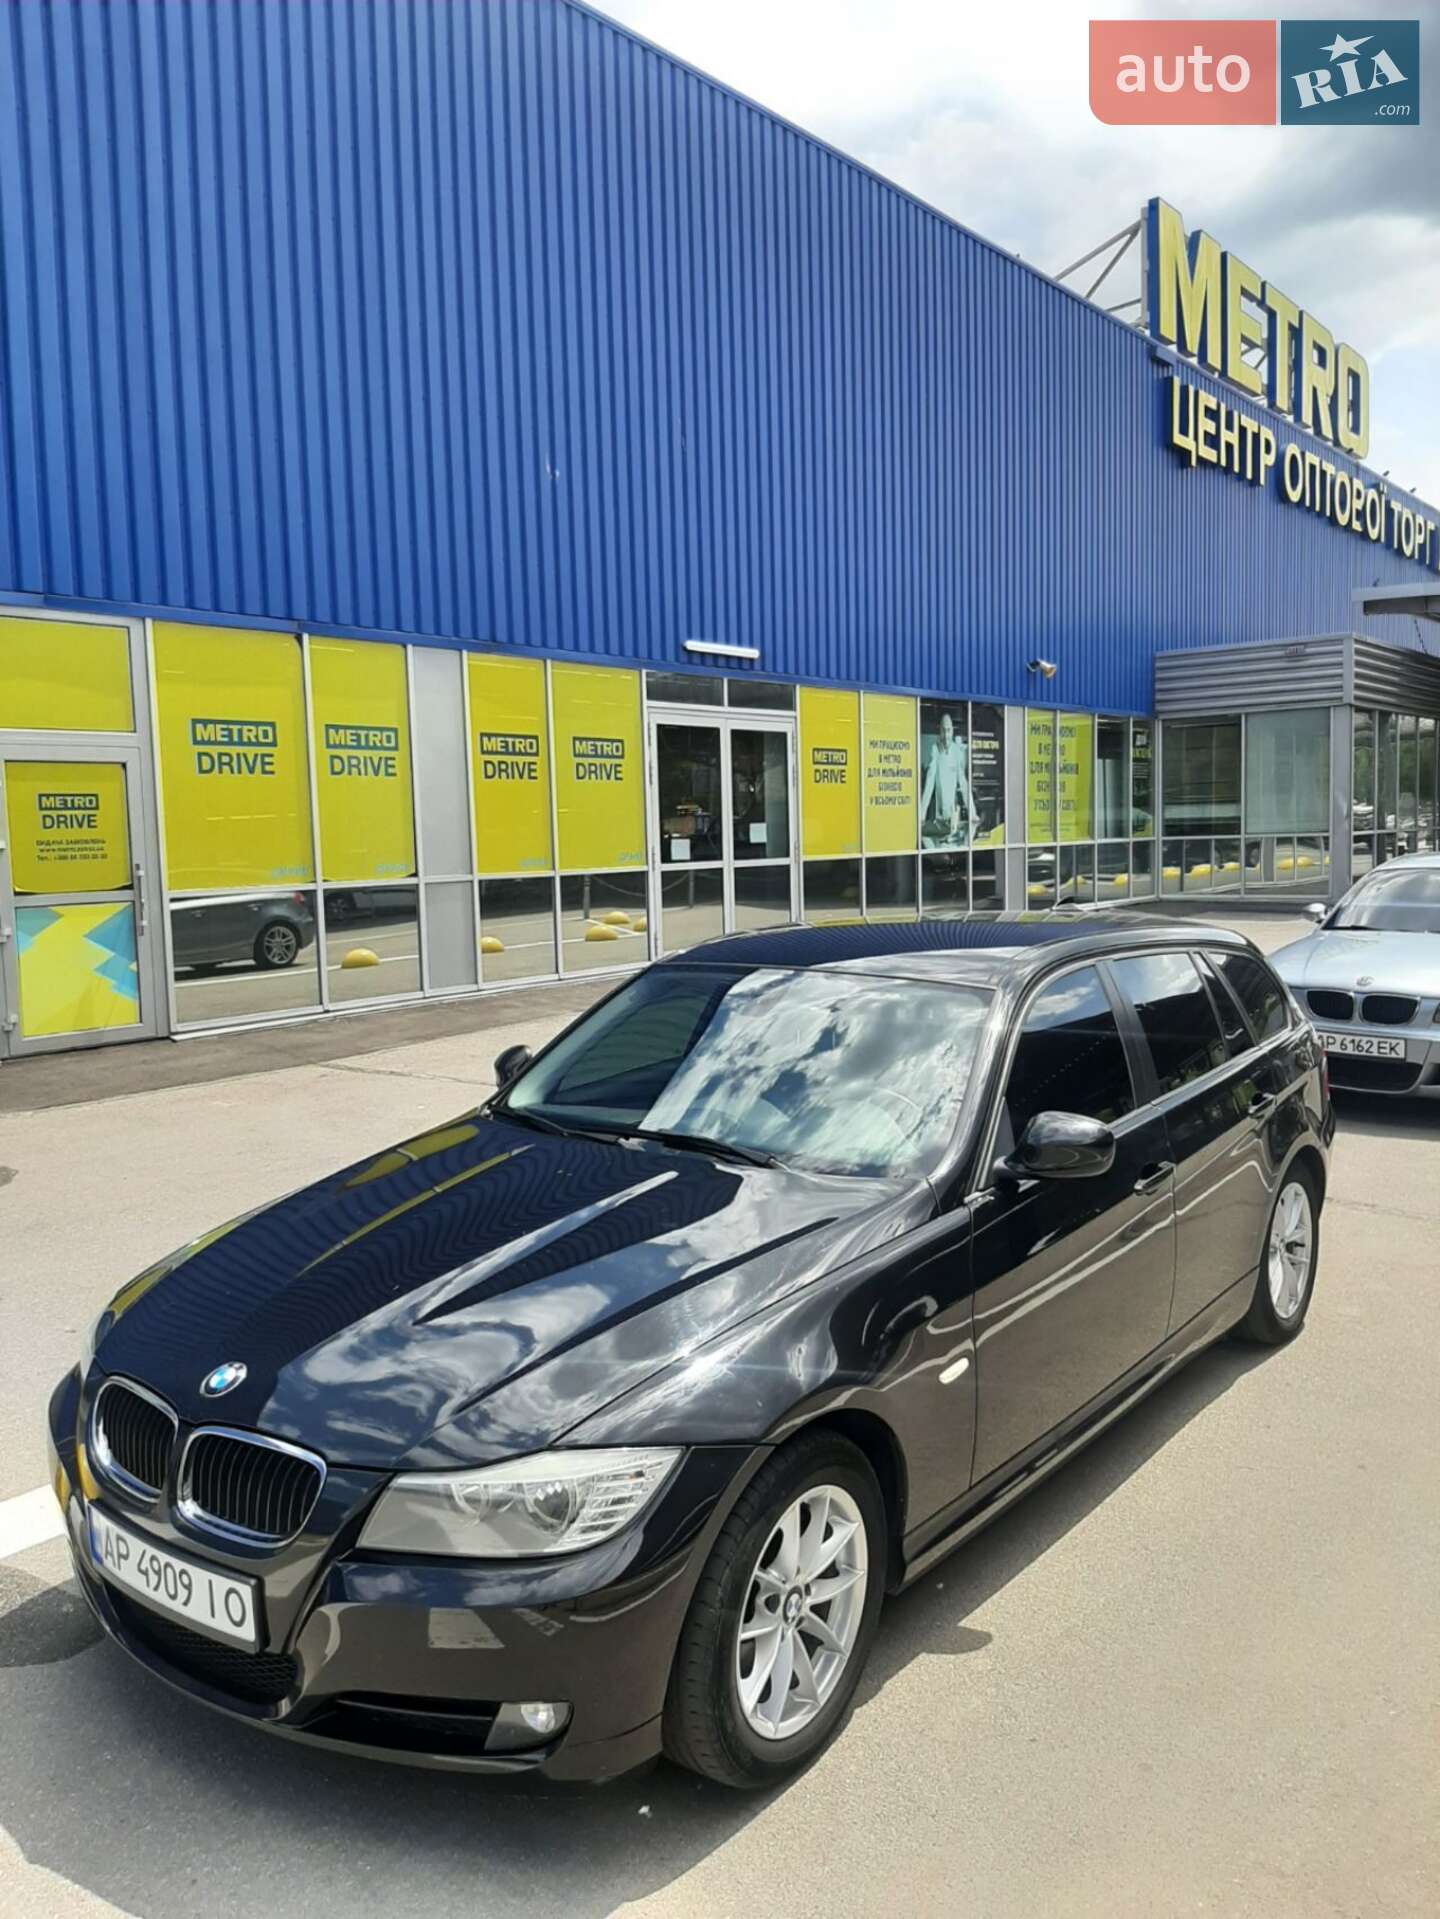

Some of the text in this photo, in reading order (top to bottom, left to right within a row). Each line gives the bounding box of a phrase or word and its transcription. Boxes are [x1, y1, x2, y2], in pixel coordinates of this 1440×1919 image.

[1150, 197, 1370, 460] METRO
[1171, 376, 1440, 572] ЦЕНТР ОПТОВОЇ ТОРГ
[195, 722, 274, 744] METRO
[328, 728, 397, 748] METRO
[481, 734, 538, 754] METRO
[574, 739, 624, 757] METRO
[197, 751, 276, 775] DRIVE
[329, 754, 397, 777] DRIVE
[814, 749, 846, 763] METRO
[483, 760, 538, 780] DRIVE
[575, 762, 624, 781] DRIVE
[814, 769, 846, 784] DRIVE
[40, 795, 98, 809] METRO
[42, 814, 97, 829] DRIVE
[1340, 1037, 1374, 1054] 6162
[1377, 1040, 1400, 1056] EK
[104, 1527, 130, 1571] AP
[137, 1549, 193, 1607] 4909
